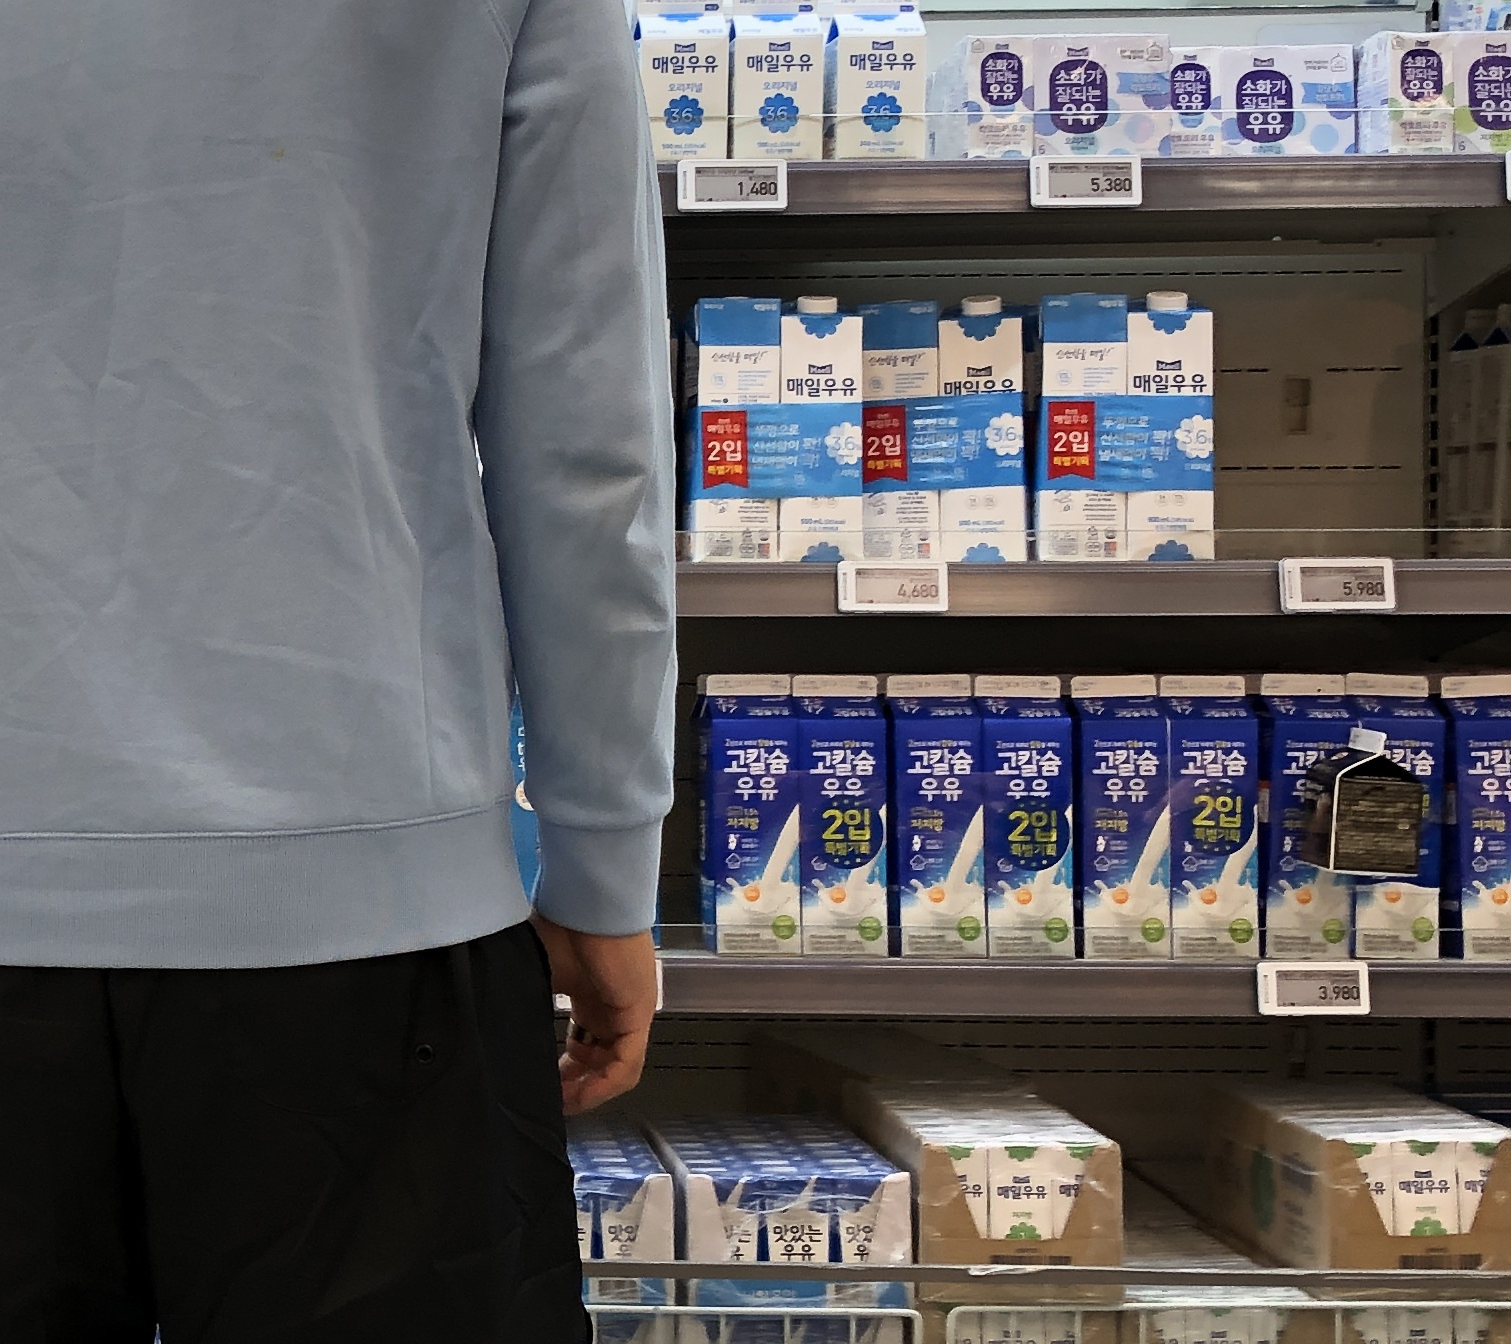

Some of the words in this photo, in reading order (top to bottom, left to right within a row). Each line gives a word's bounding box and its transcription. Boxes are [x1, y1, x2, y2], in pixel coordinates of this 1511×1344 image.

[652, 55, 718, 74] 매일우유
[747, 53, 813, 73] 매일우유
[849, 53, 917, 73] 매일우유
[987, 85, 1017, 101] 우유
[1407, 80, 1435, 96] 우유
[1060, 103, 1099, 126] 우유
[1246, 112, 1285, 136] 우유
[786, 378, 856, 398] 매일우유
[1133, 374, 1207, 394] 매일우유
[707, 440, 742, 462] 2입
[867, 434, 901, 456] 2입
[1053, 431, 1089, 453] 2입
[723, 749, 790, 776] 고칼슘
[810, 749, 876, 776] 고칼슘
[906, 749, 974, 776] 고칼슘
[995, 749, 1062, 776] 고칼슘
[1092, 749, 1160, 776] 고칼슘
[1180, 749, 1247, 776] 고칼슘
[735, 778, 779, 801] 우유
[919, 778, 963, 801] 우유
[1104, 778, 1148, 803] 우유
[1193, 795, 1242, 827] 2입
[822, 808, 871, 842] 2입
[1007, 810, 1058, 844] 2입
[773, 1224, 824, 1244] 맛있는
[780, 1244, 816, 1261] 우유
